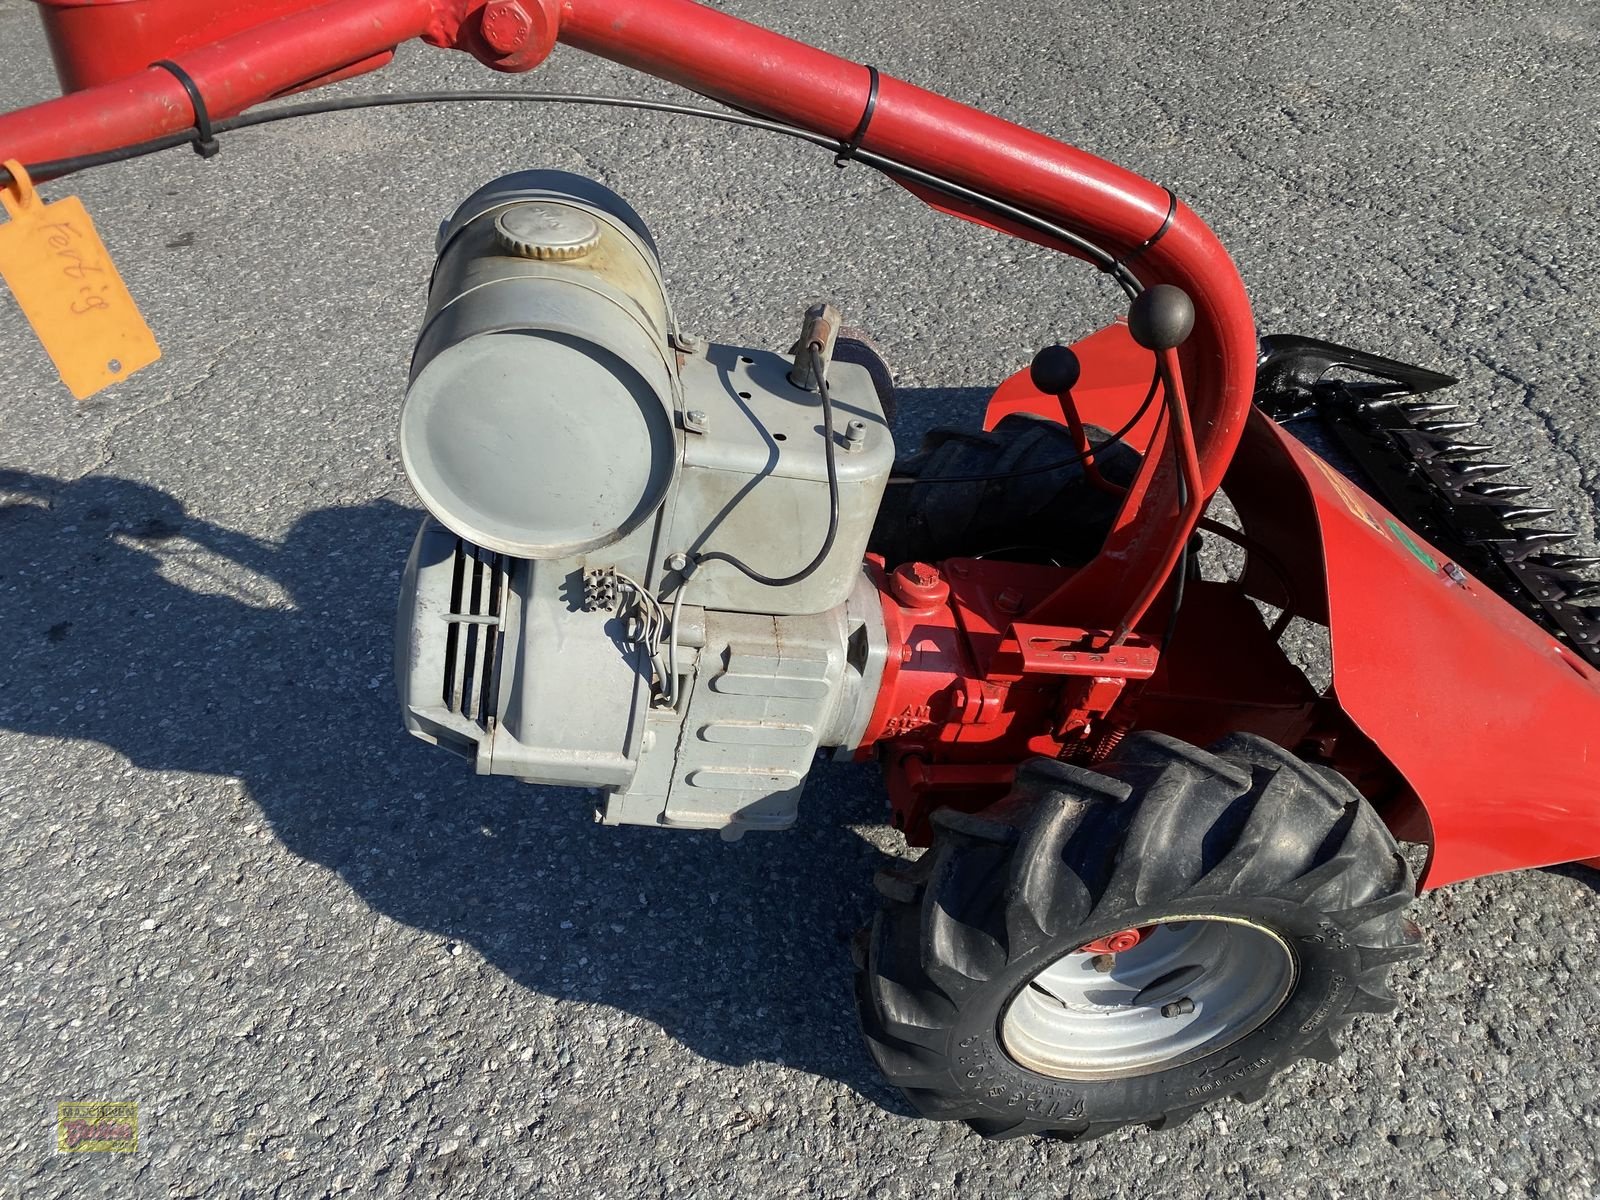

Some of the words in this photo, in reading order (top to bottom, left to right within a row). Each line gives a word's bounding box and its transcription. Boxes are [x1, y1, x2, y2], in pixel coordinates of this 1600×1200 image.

[37, 222, 109, 314] Fertig
[900, 704, 930, 717] AM
[1186, 1057, 1271, 1097] TRACTOR
